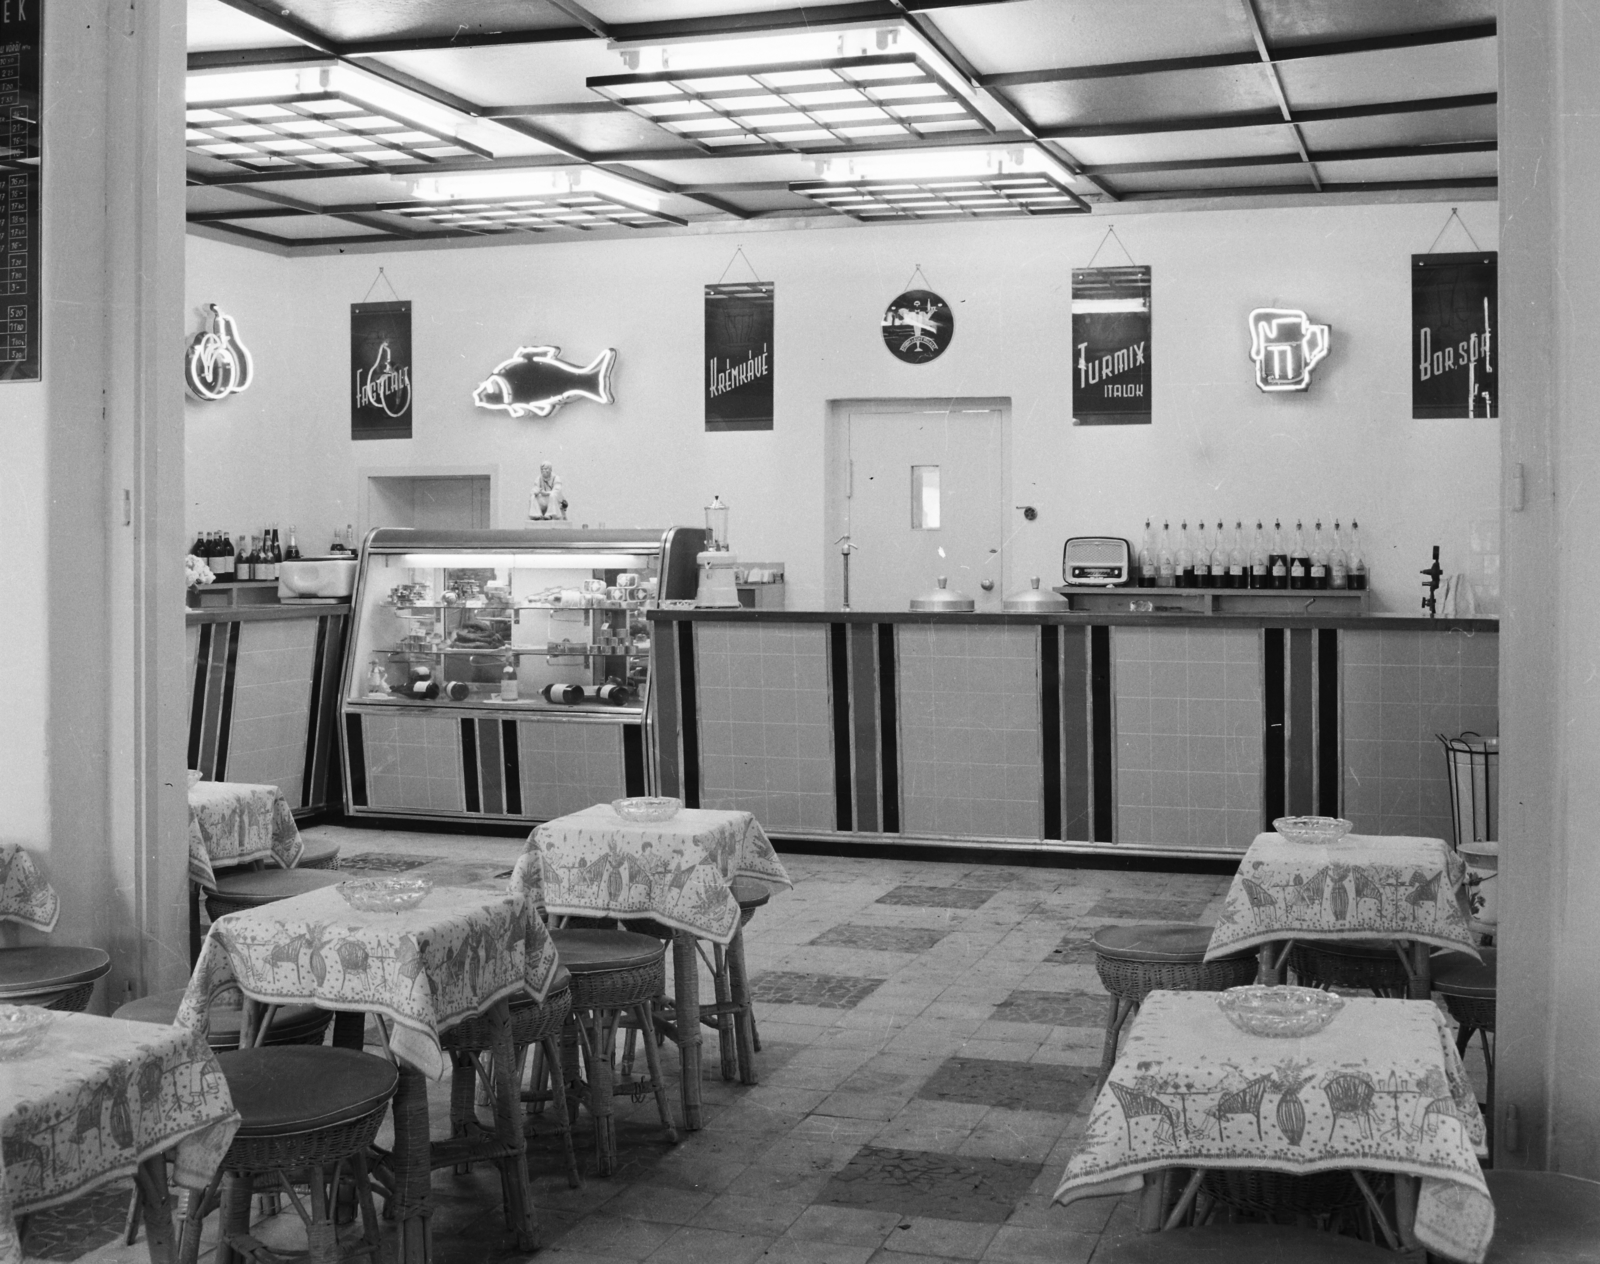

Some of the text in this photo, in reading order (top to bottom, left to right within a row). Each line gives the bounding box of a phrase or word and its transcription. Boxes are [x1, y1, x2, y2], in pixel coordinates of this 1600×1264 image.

[709, 342, 768, 398] KRÉMKÁVÉ
[1077, 341, 1145, 389] TURMIX
[1104, 384, 1144, 398] ITALOK
